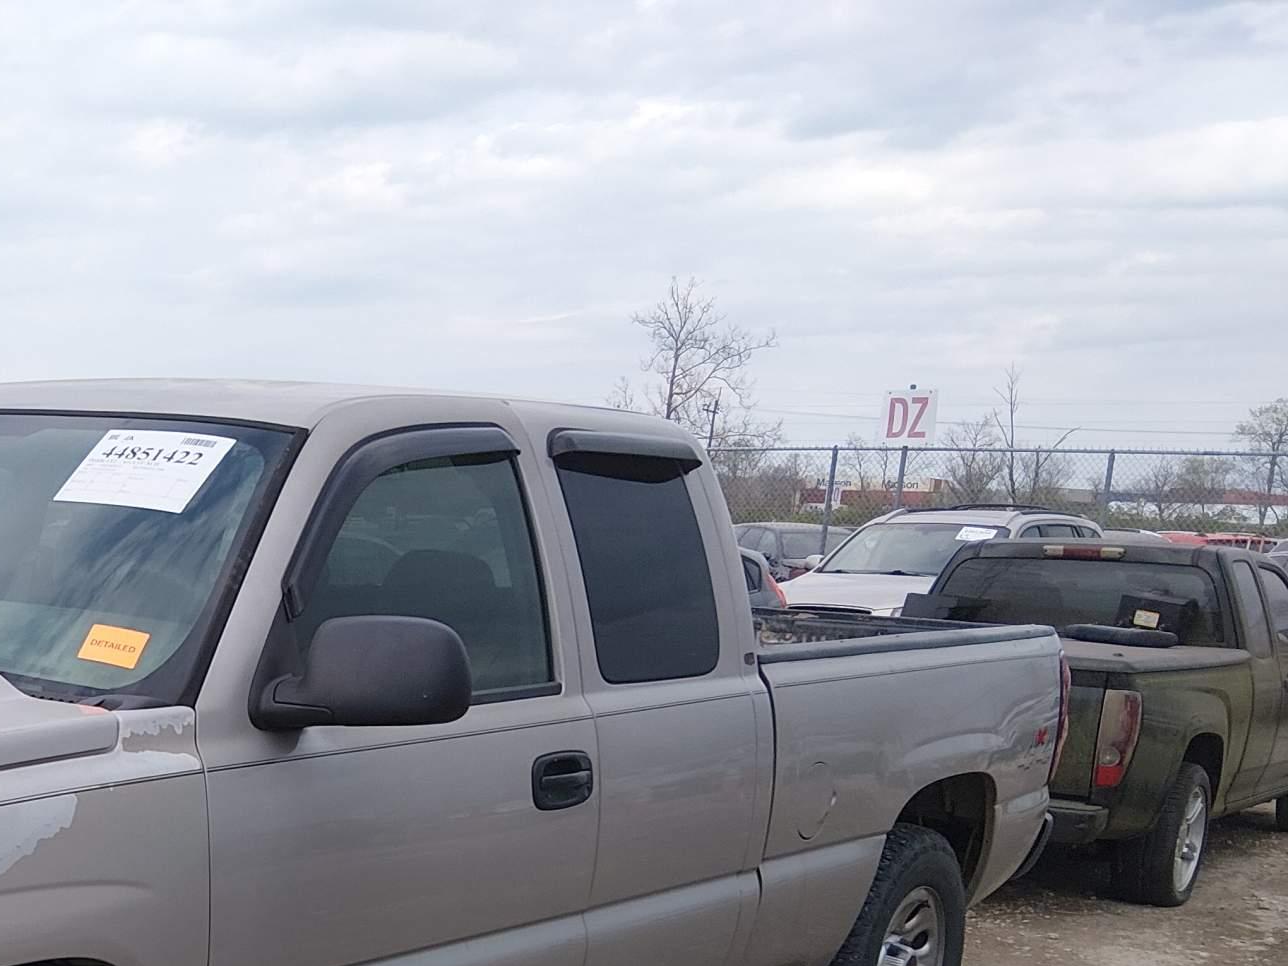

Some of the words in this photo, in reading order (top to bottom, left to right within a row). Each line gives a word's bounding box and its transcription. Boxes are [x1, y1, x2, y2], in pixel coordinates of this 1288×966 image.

[885, 396, 929, 439] DZ
[102, 445, 204, 466] 44851422
[881, 480, 919, 489] Mason
[90, 638, 137, 653] DETAILED
